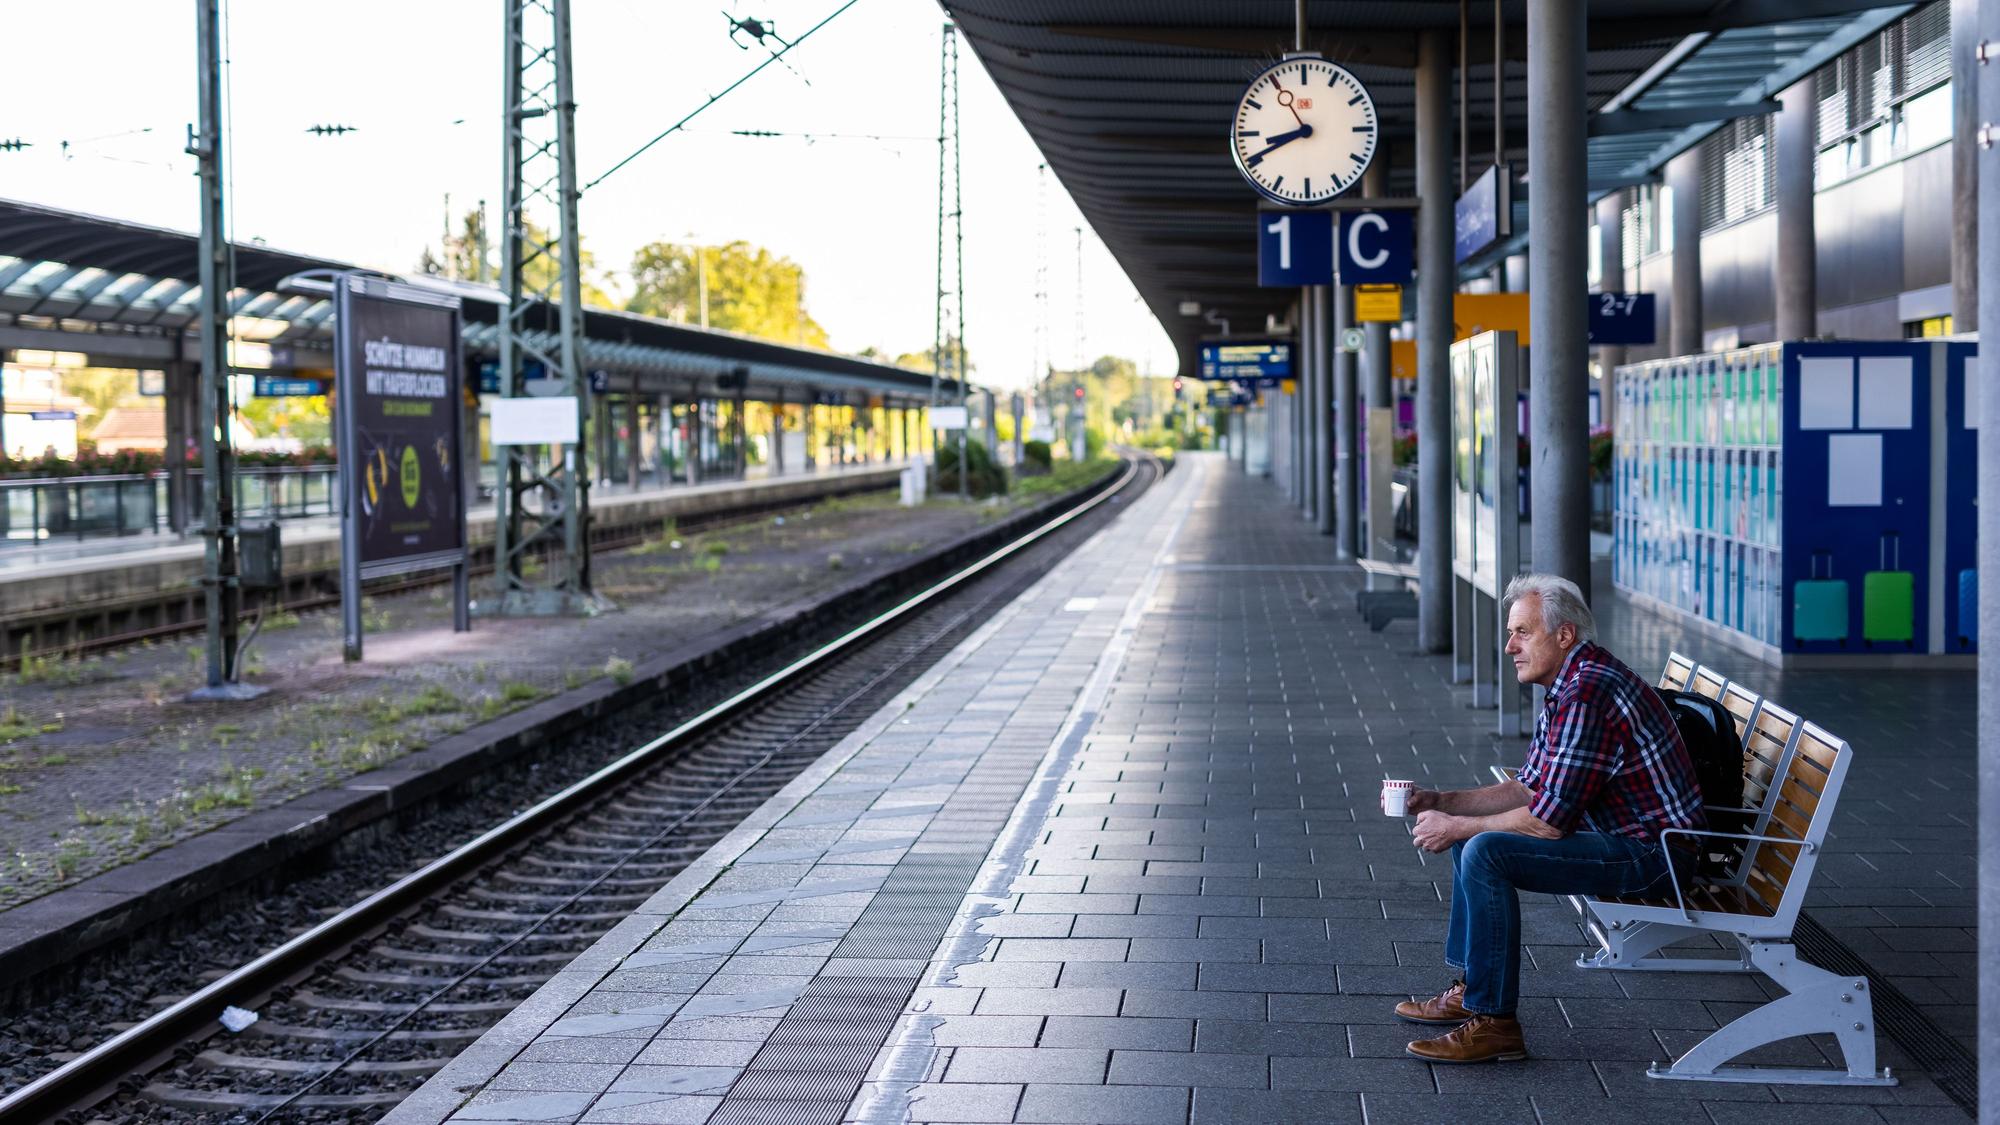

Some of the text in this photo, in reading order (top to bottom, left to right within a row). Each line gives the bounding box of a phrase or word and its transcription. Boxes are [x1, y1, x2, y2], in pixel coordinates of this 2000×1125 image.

[1267, 215, 1291, 270] 1
[1348, 213, 1390, 269] C
[1600, 292, 1638, 316] 2-7
